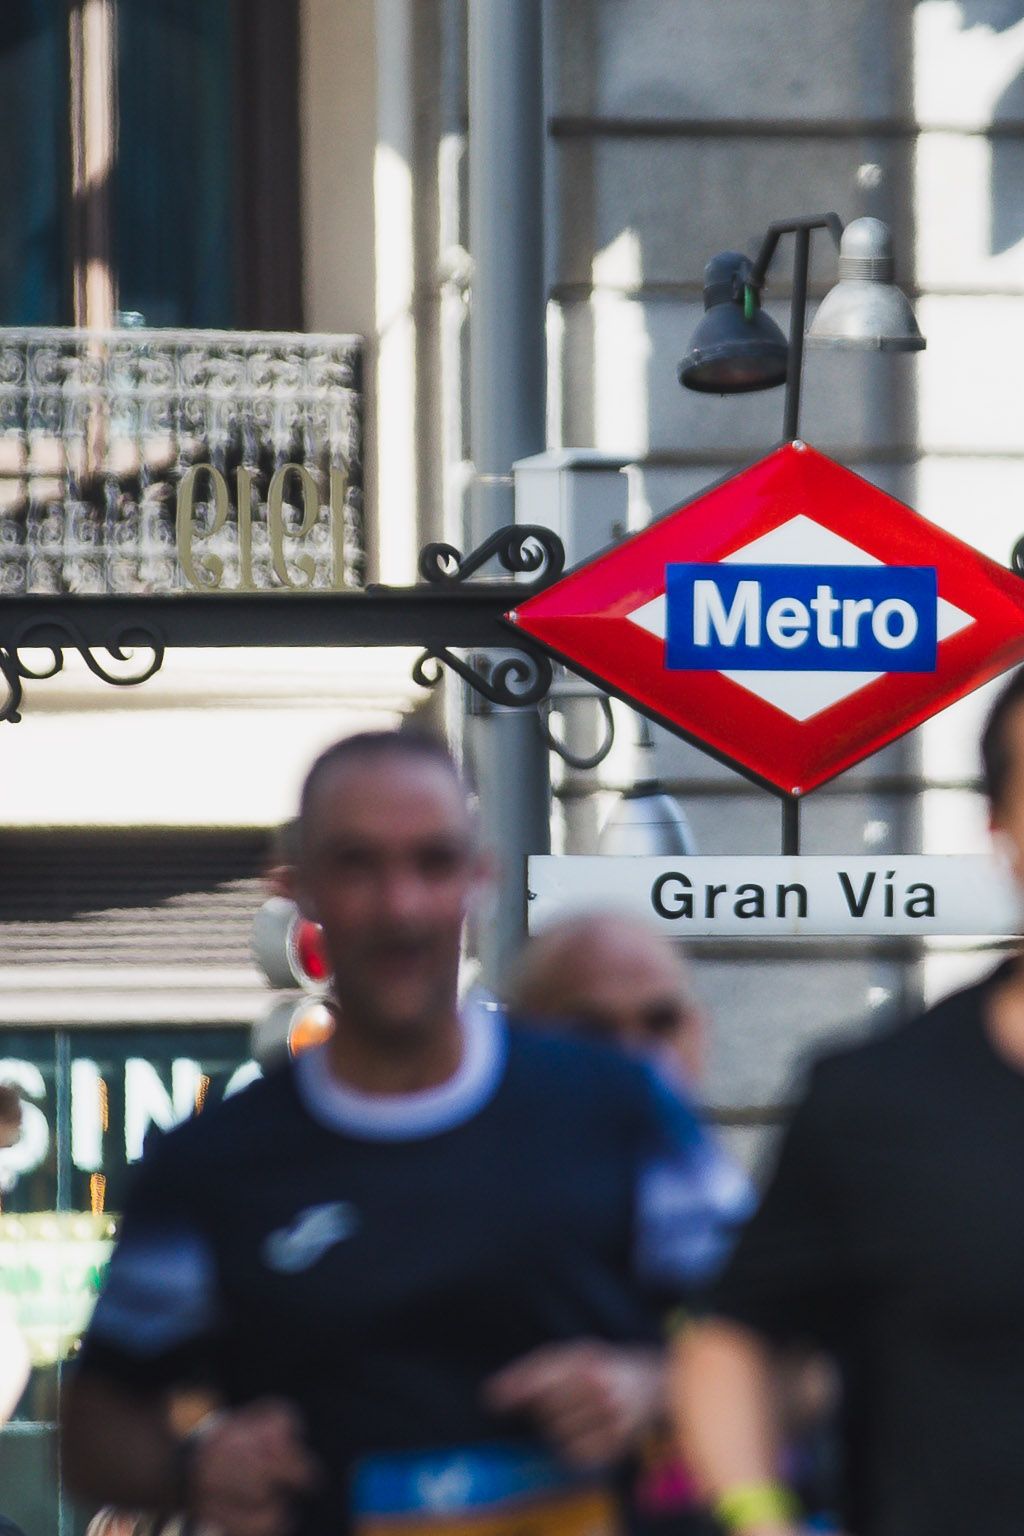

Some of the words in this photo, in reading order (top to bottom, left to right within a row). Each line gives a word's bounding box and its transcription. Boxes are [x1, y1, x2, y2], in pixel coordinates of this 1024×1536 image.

[692, 579, 919, 650] Metro
[650, 871, 809, 920] Gran
[837, 869, 937, 919] Vía
